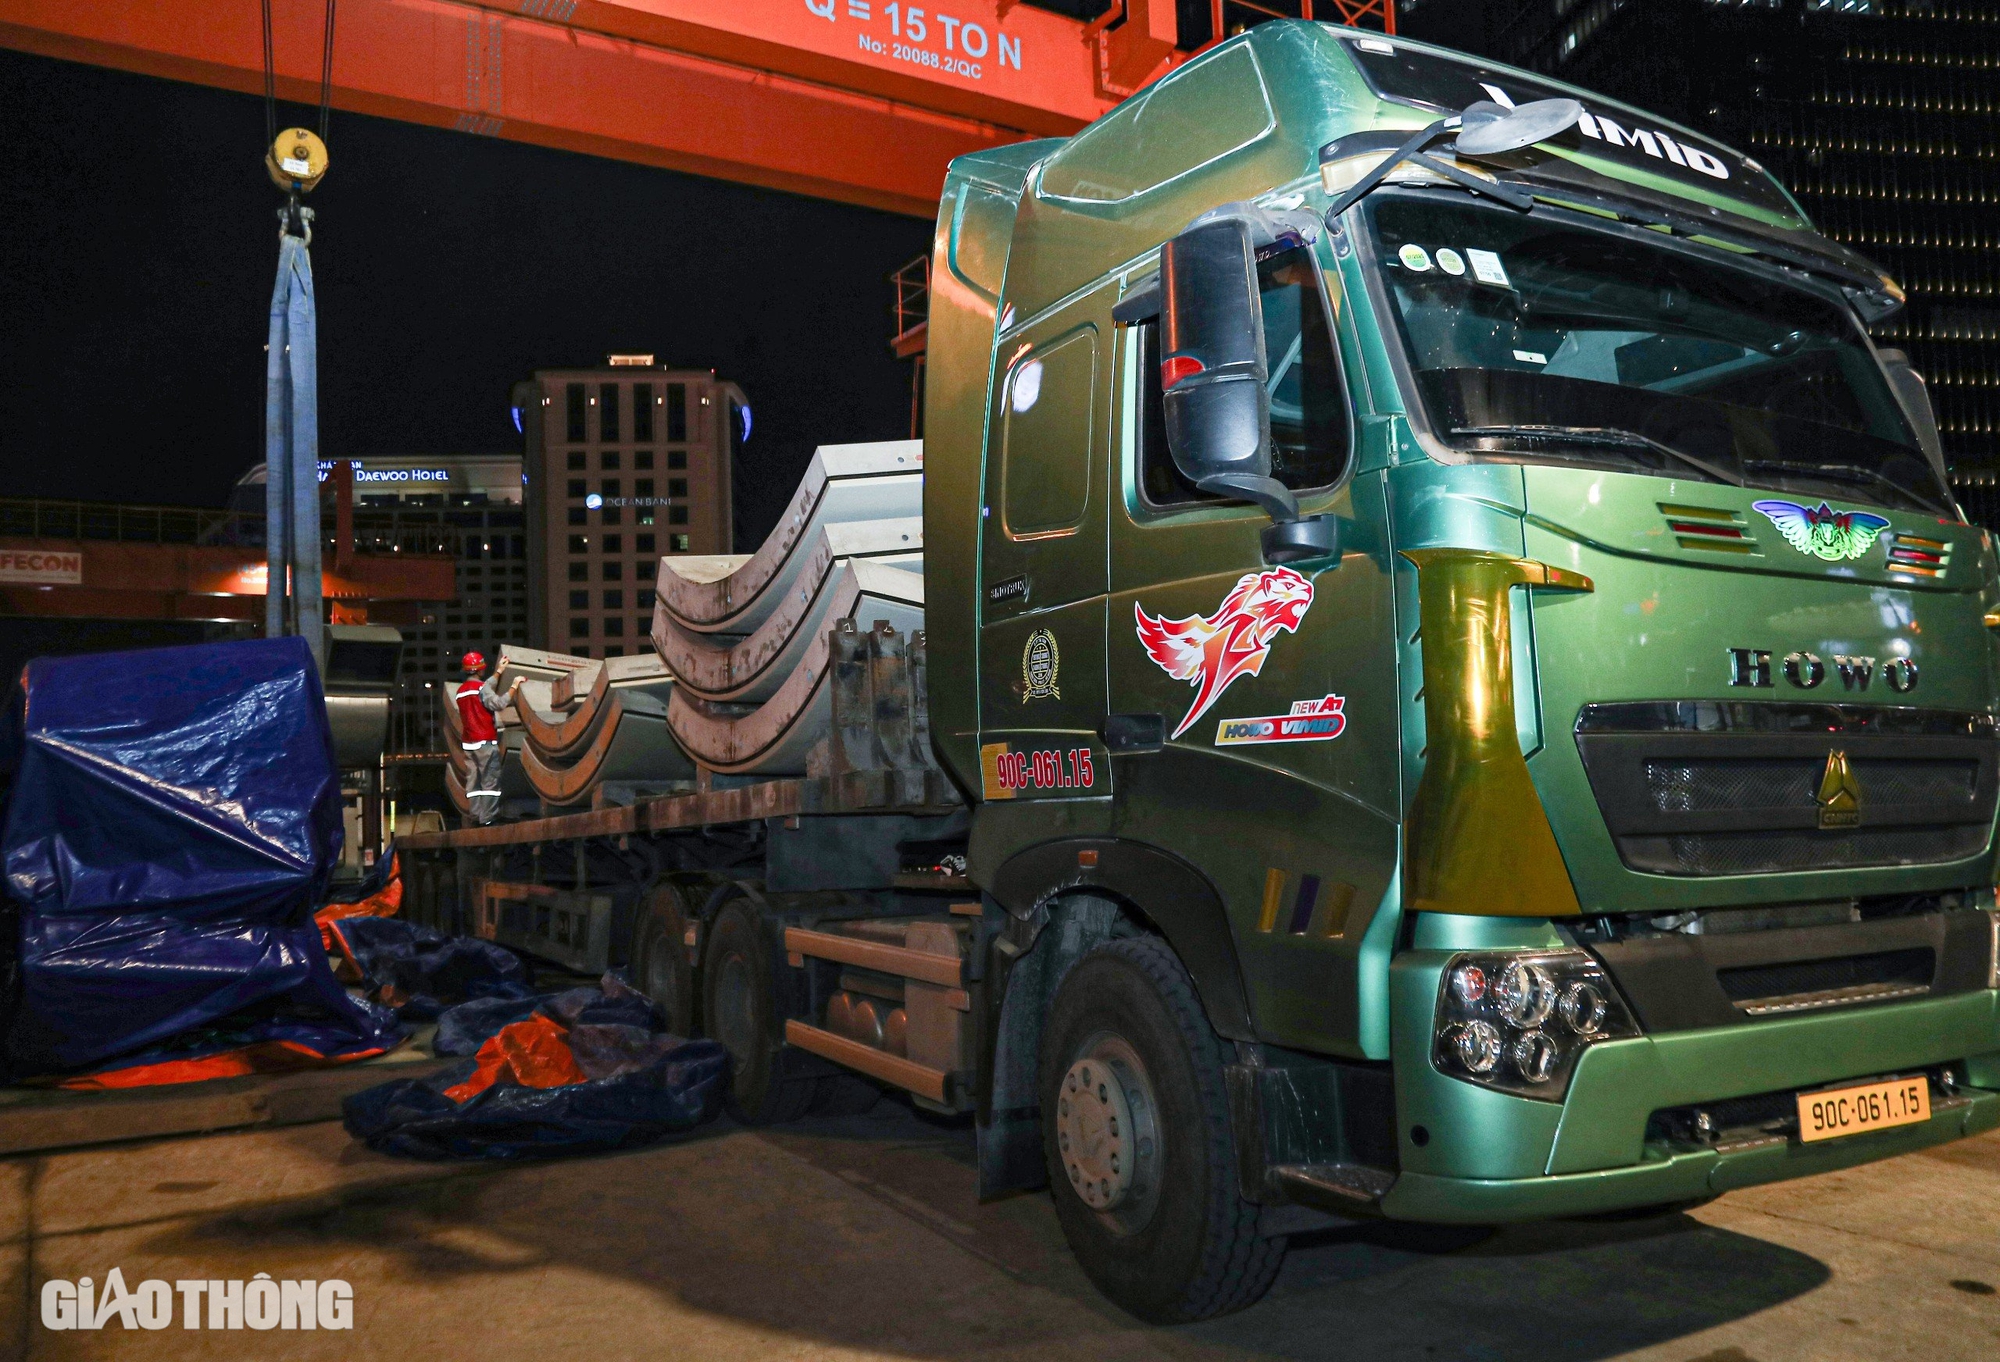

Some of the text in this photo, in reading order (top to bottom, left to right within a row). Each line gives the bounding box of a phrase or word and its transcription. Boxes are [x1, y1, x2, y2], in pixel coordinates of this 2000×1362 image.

[884, 2, 927, 42] 15
[858, 34, 983, 79] No: 20088.2/QC
[356, 470, 409, 482] DAEWOO
[1726, 647, 1919, 694] HOWO
[1319, 696, 1343, 713] A7
[1224, 722, 1275, 739] HOWO
[997, 748, 1094, 789] 90C-061.15
